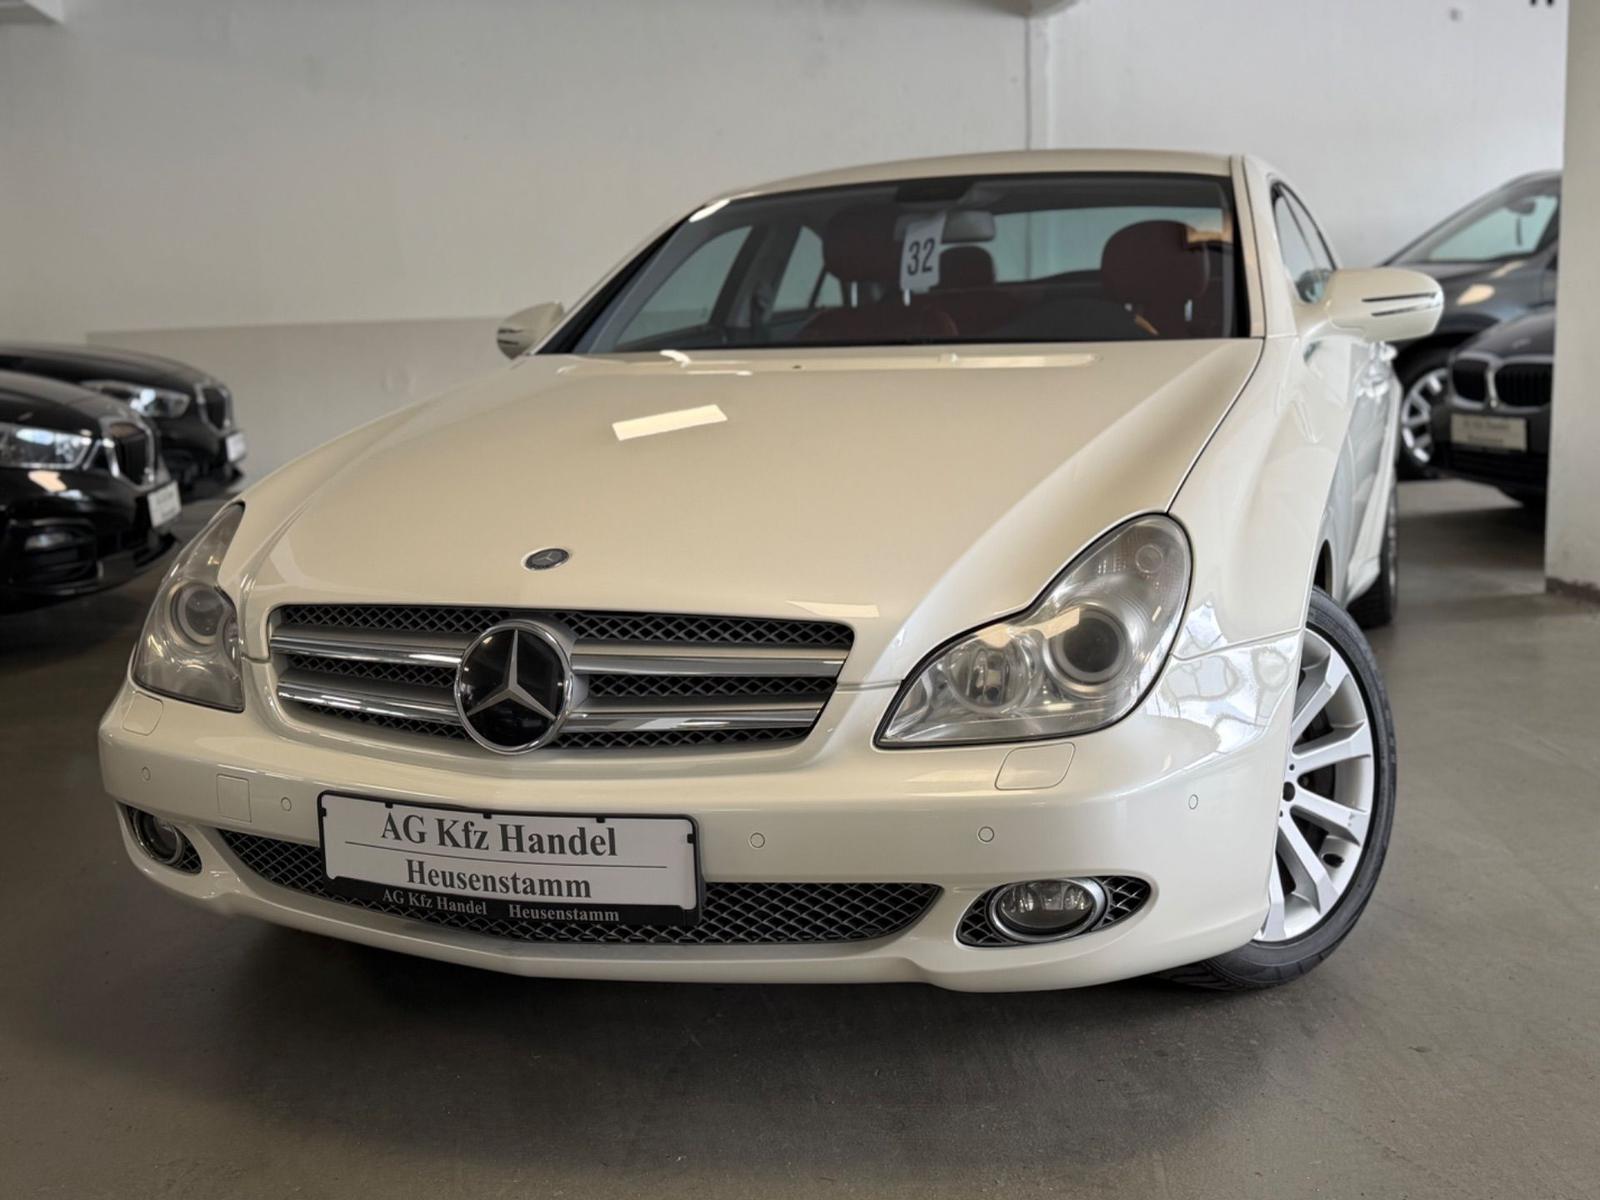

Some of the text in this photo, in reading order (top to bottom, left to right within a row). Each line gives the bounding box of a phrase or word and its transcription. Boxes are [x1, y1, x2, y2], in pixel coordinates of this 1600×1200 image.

[907, 237, 936, 276] 32
[381, 811, 618, 856] AG Kfz Handel
[405, 858, 592, 898] Heusenstamm
[383, 889, 620, 922] AG Kfz Handel Heusenstamm
